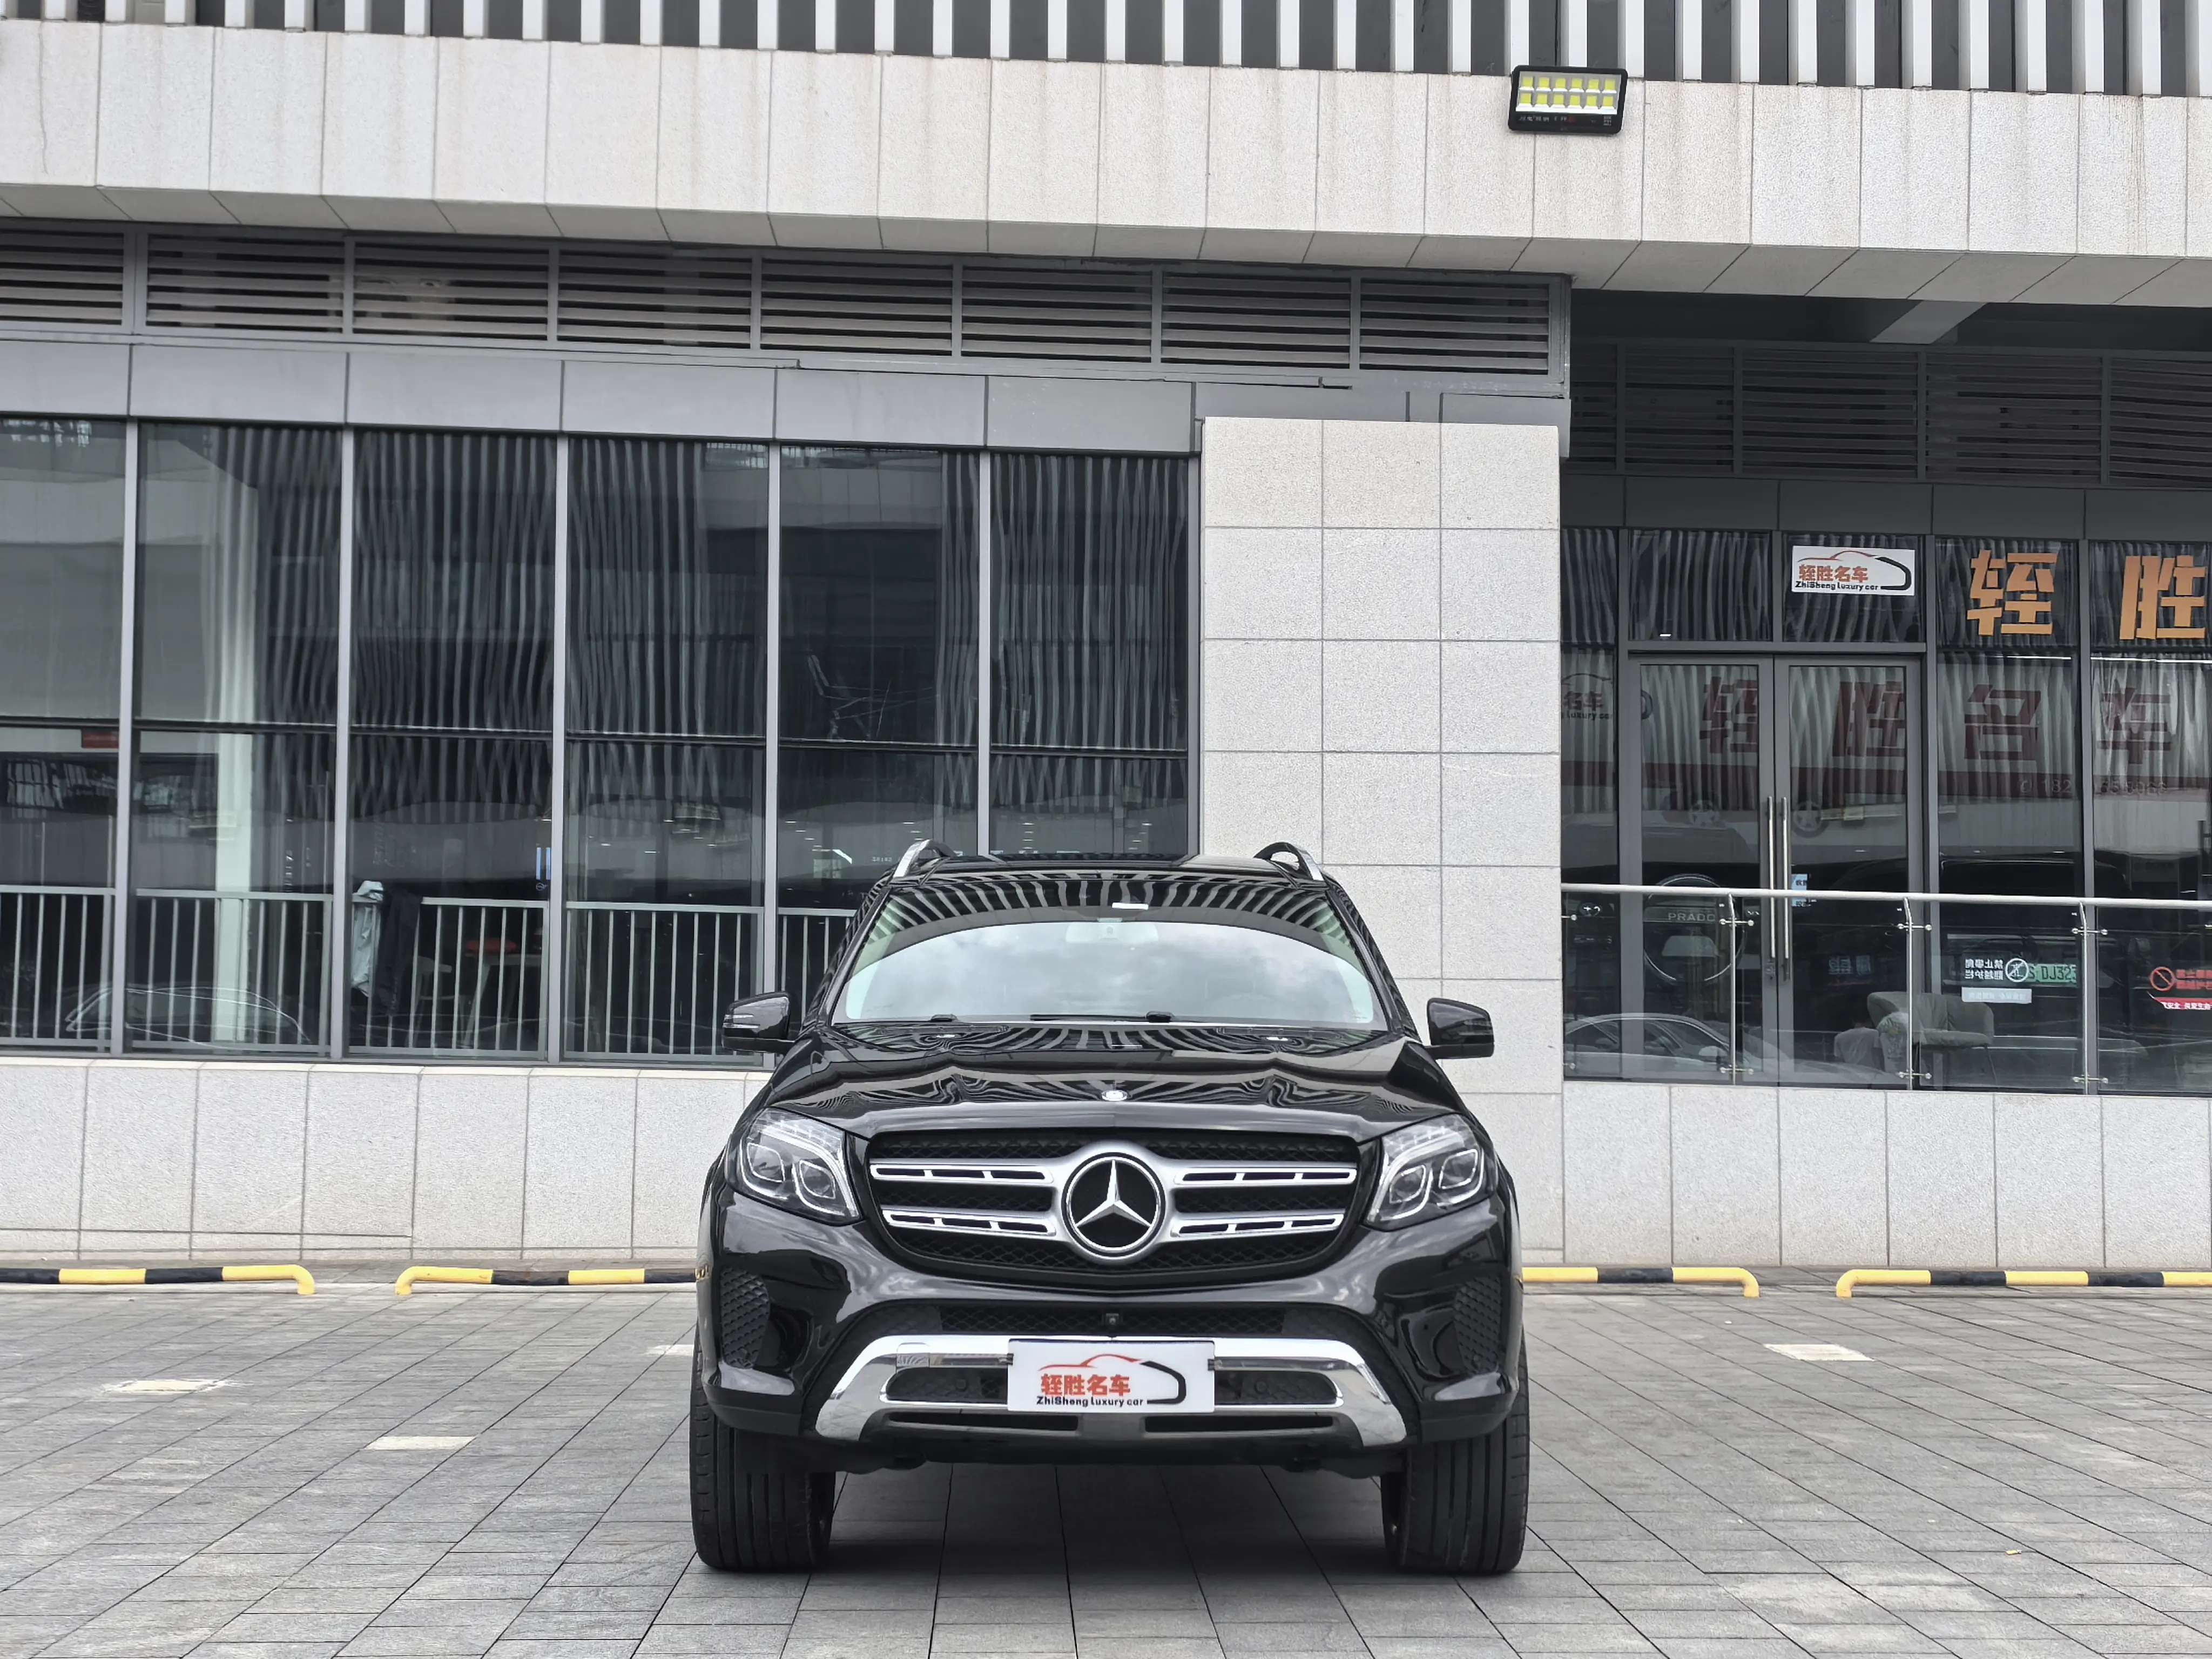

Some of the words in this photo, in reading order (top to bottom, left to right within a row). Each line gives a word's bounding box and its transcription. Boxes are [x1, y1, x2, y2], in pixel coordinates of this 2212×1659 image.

[1668, 913, 1715, 922] PRADO
[1041, 1373, 1130, 1397] 轾胜名车
[1036, 1395, 1088, 1408] ZhiSheng
